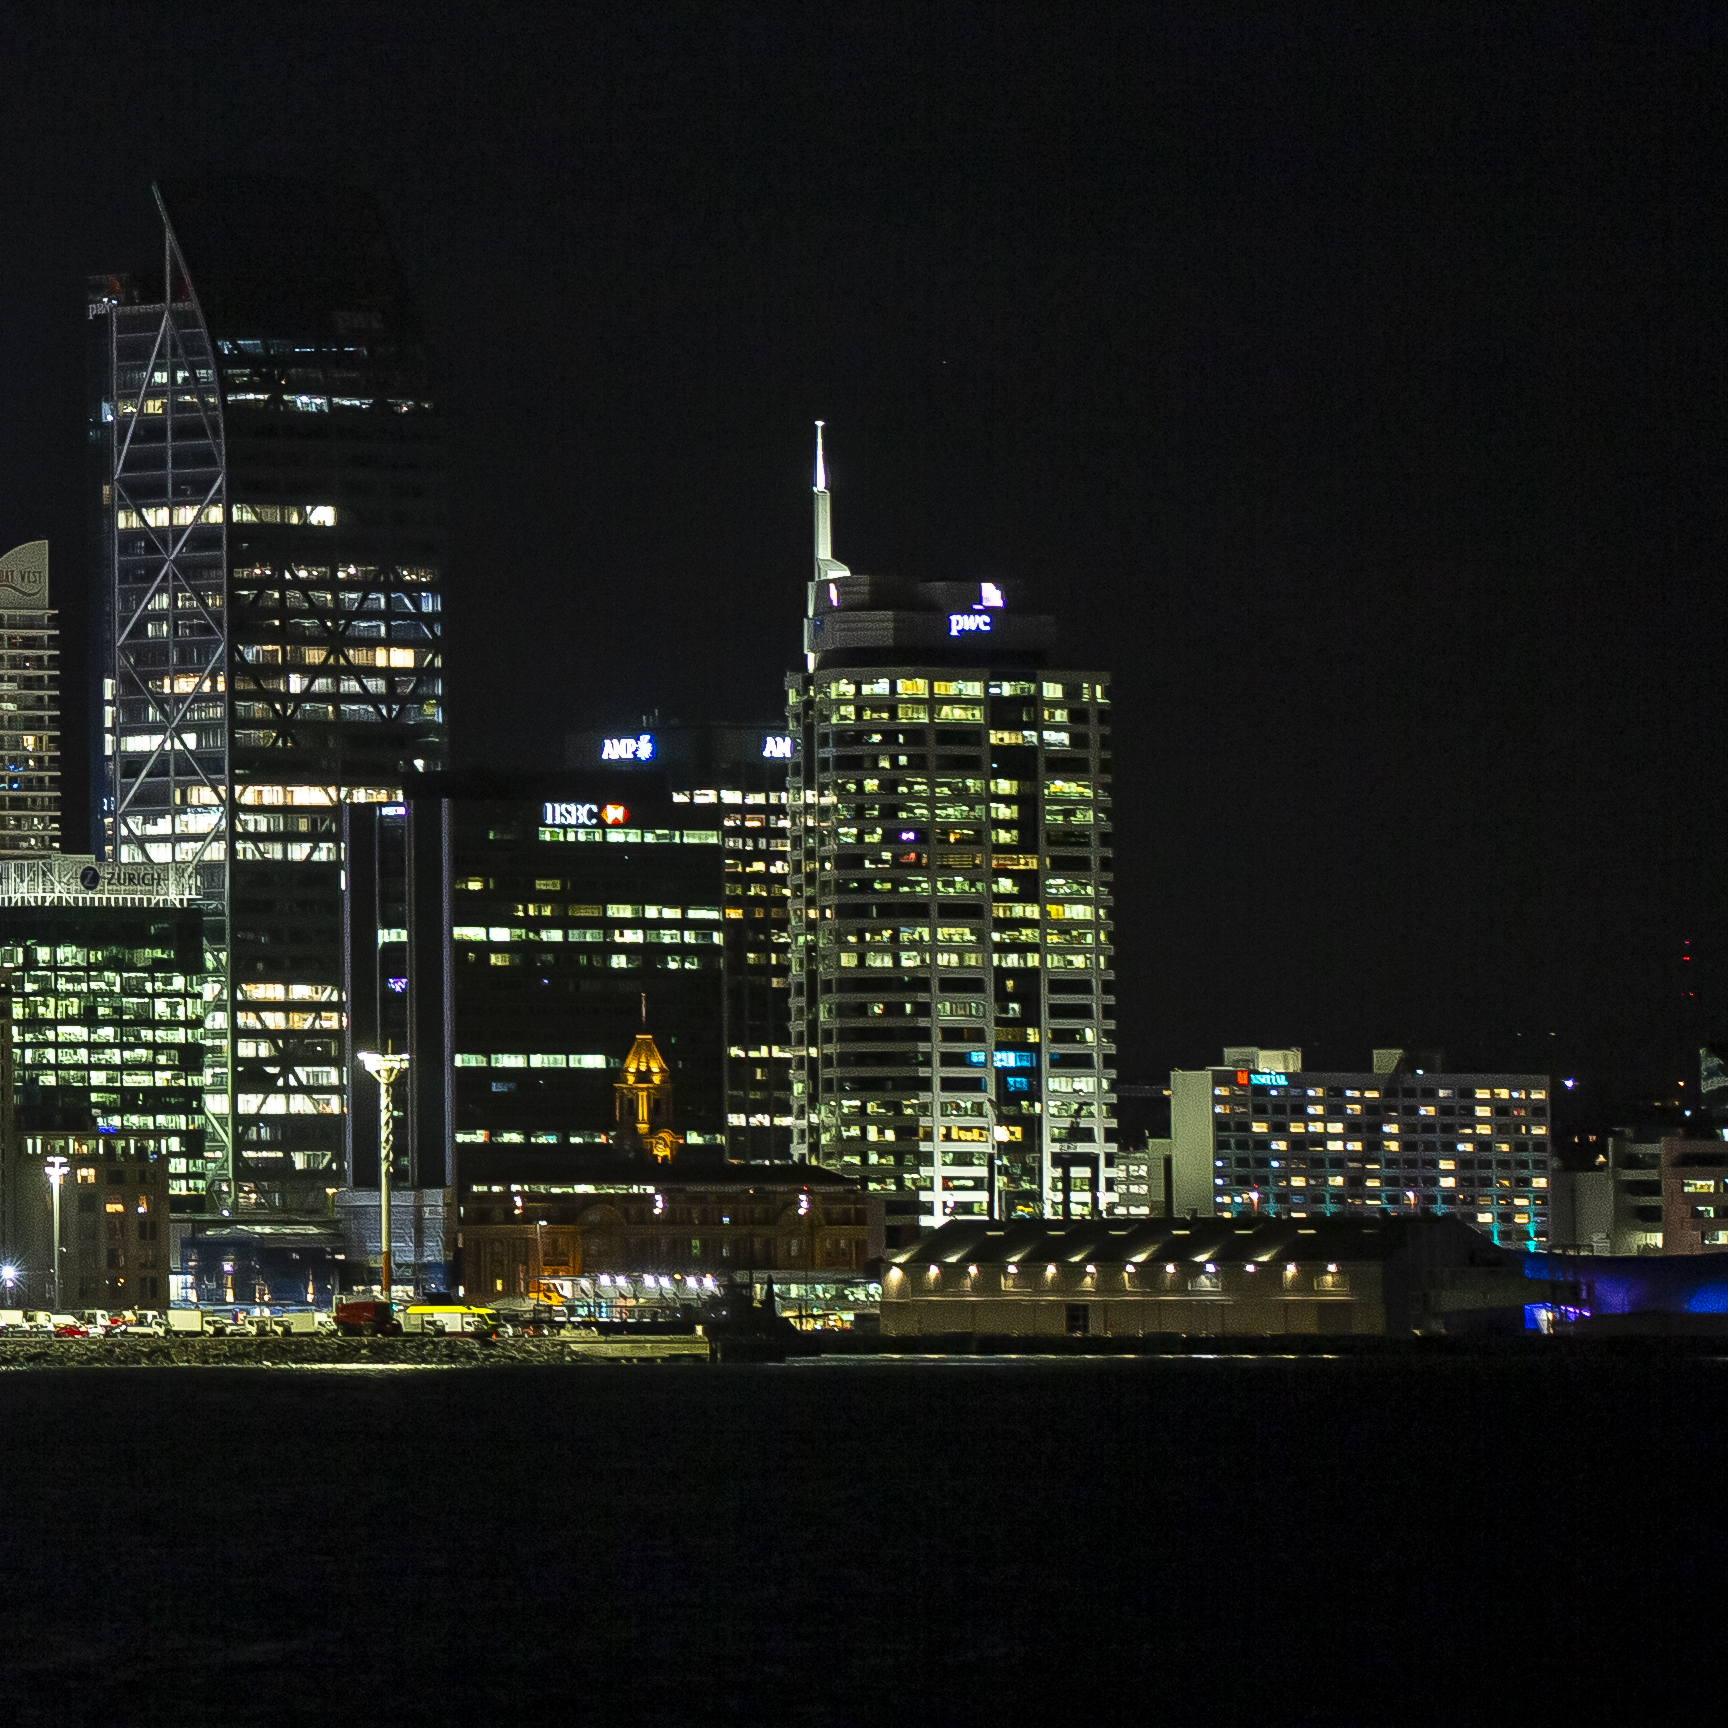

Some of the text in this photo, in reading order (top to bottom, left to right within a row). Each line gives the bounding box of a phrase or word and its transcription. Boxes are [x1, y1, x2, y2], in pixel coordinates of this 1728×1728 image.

[949, 614, 991, 636] pwc
[544, 803, 598, 825] HSBC
[106, 871, 161, 886] ZURICH
